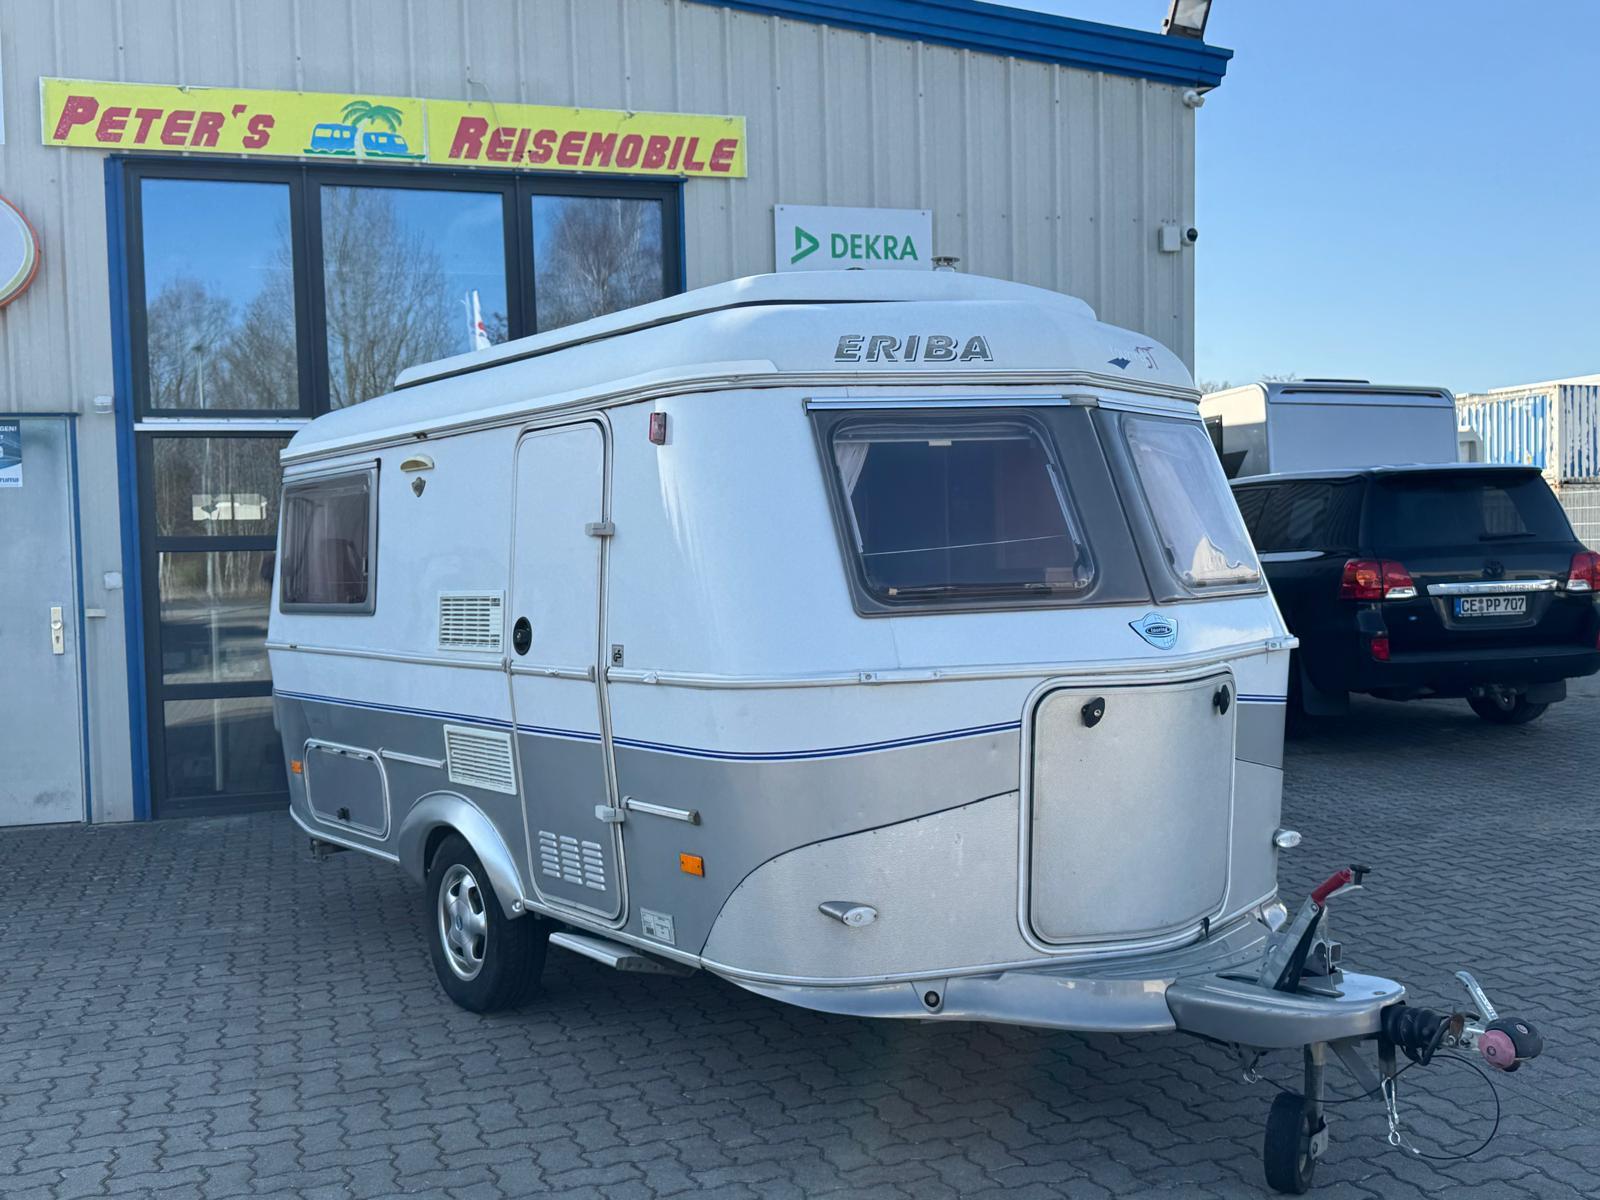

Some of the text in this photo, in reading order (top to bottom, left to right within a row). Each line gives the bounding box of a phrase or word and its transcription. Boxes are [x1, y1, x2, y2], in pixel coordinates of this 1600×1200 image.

[448, 116, 739, 172] REISEMOBILE
[831, 233, 918, 261] DEKRA
[834, 335, 994, 362] ERIBA
[1503, 597, 1525, 610] 707
